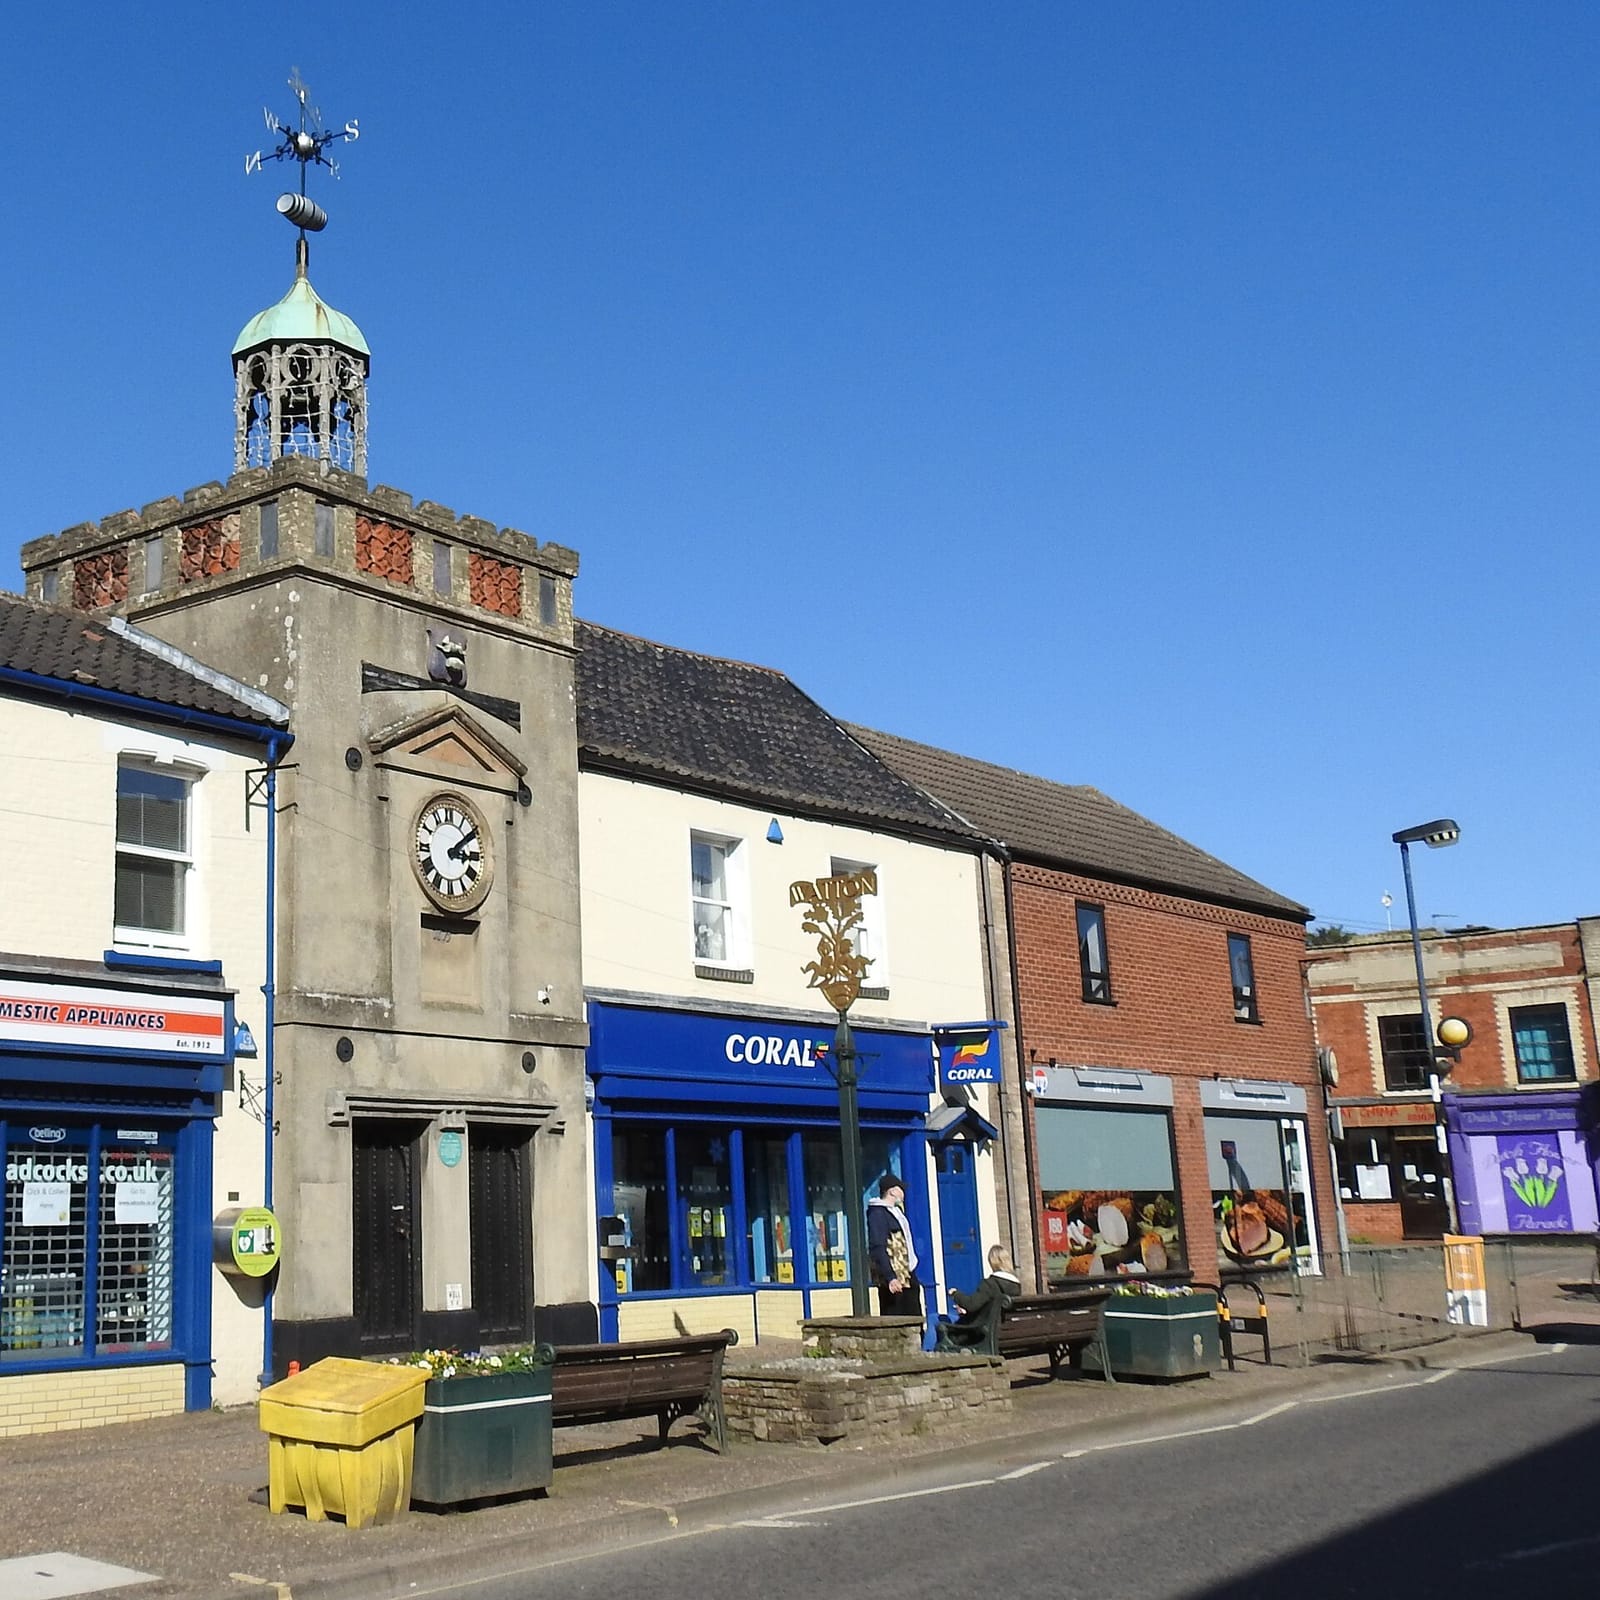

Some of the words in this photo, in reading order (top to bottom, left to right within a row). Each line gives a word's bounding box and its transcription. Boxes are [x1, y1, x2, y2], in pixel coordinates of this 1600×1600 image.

[344, 119, 360, 142] S
[790, 876, 876, 903] WATTON
[66, 1008, 165, 1029] APPLIANCES
[176, 1039, 190, 1048] Est.
[192, 1040, 211, 1049] 1912
[725, 1034, 816, 1068] CORAL
[947, 1068, 994, 1081] CORAL
[6, 1157, 88, 1182] adcocks
[100, 1160, 158, 1182] .co.uk
